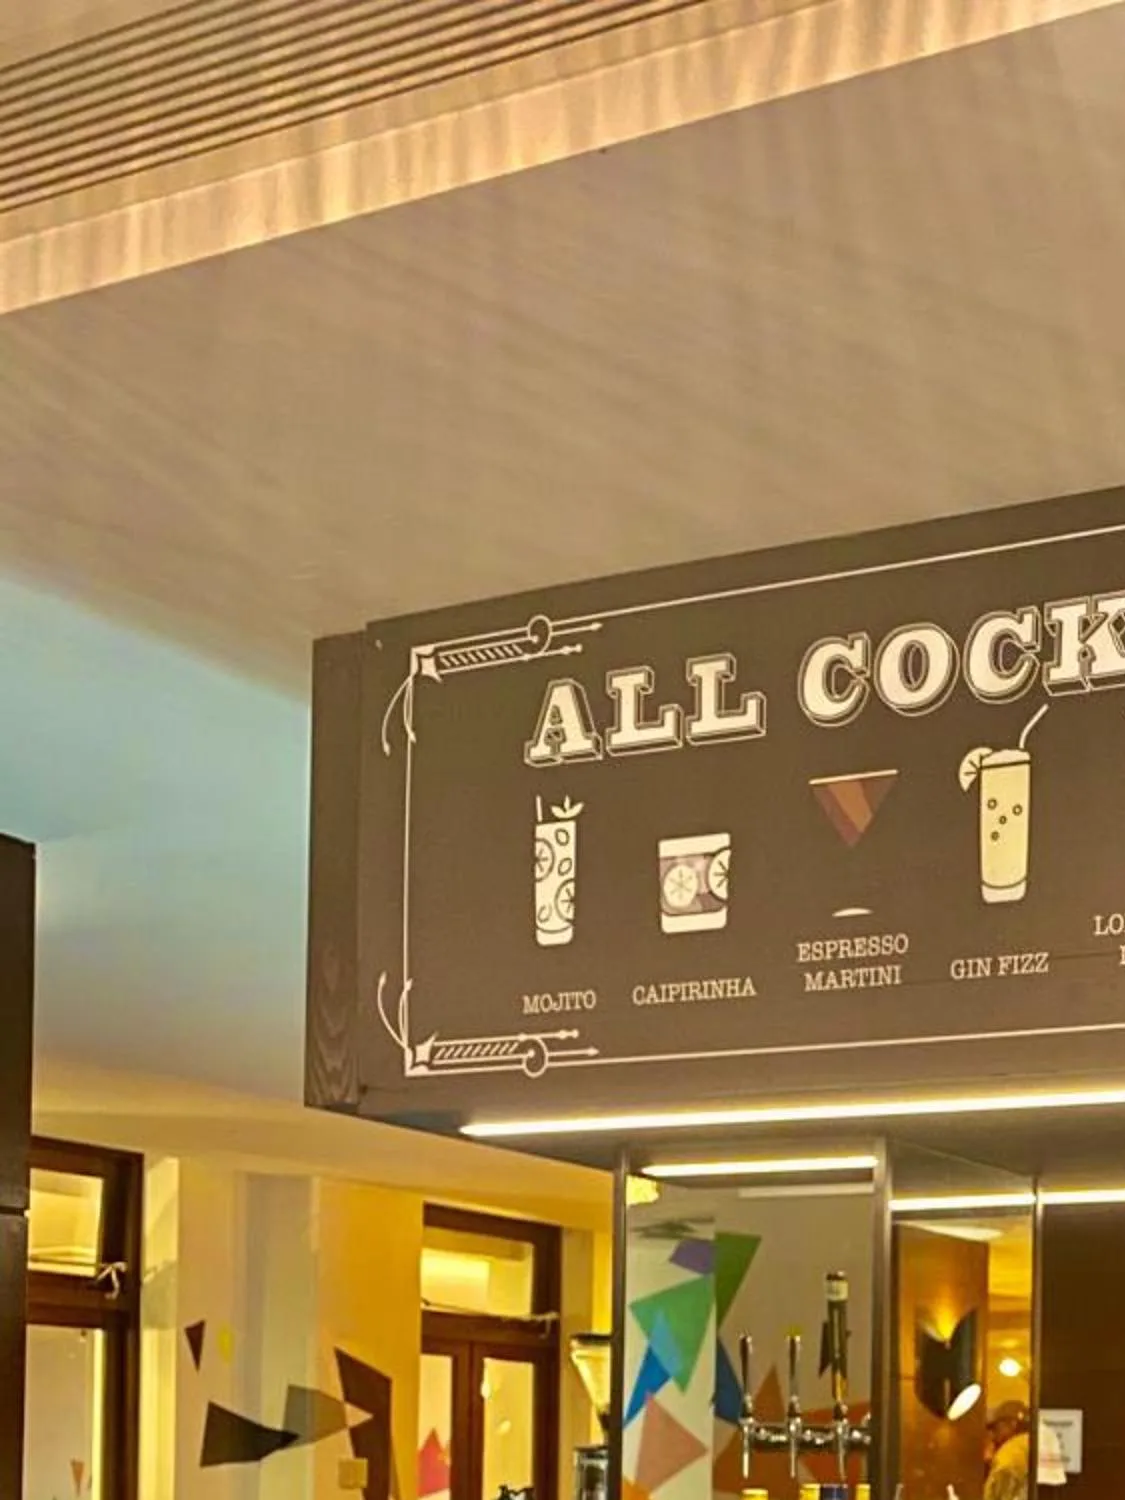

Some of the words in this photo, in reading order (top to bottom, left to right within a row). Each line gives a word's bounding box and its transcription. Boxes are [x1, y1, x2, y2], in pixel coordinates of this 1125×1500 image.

[524, 653, 767, 767] ALL
[796, 932, 909, 963] ESPRESSO
[804, 965, 902, 992] MARTINI
[950, 957, 993, 980] GIN
[998, 951, 1049, 978] FIZZ
[523, 989, 597, 1015] MOJITO
[632, 976, 757, 1005] CAIPIRINHA
